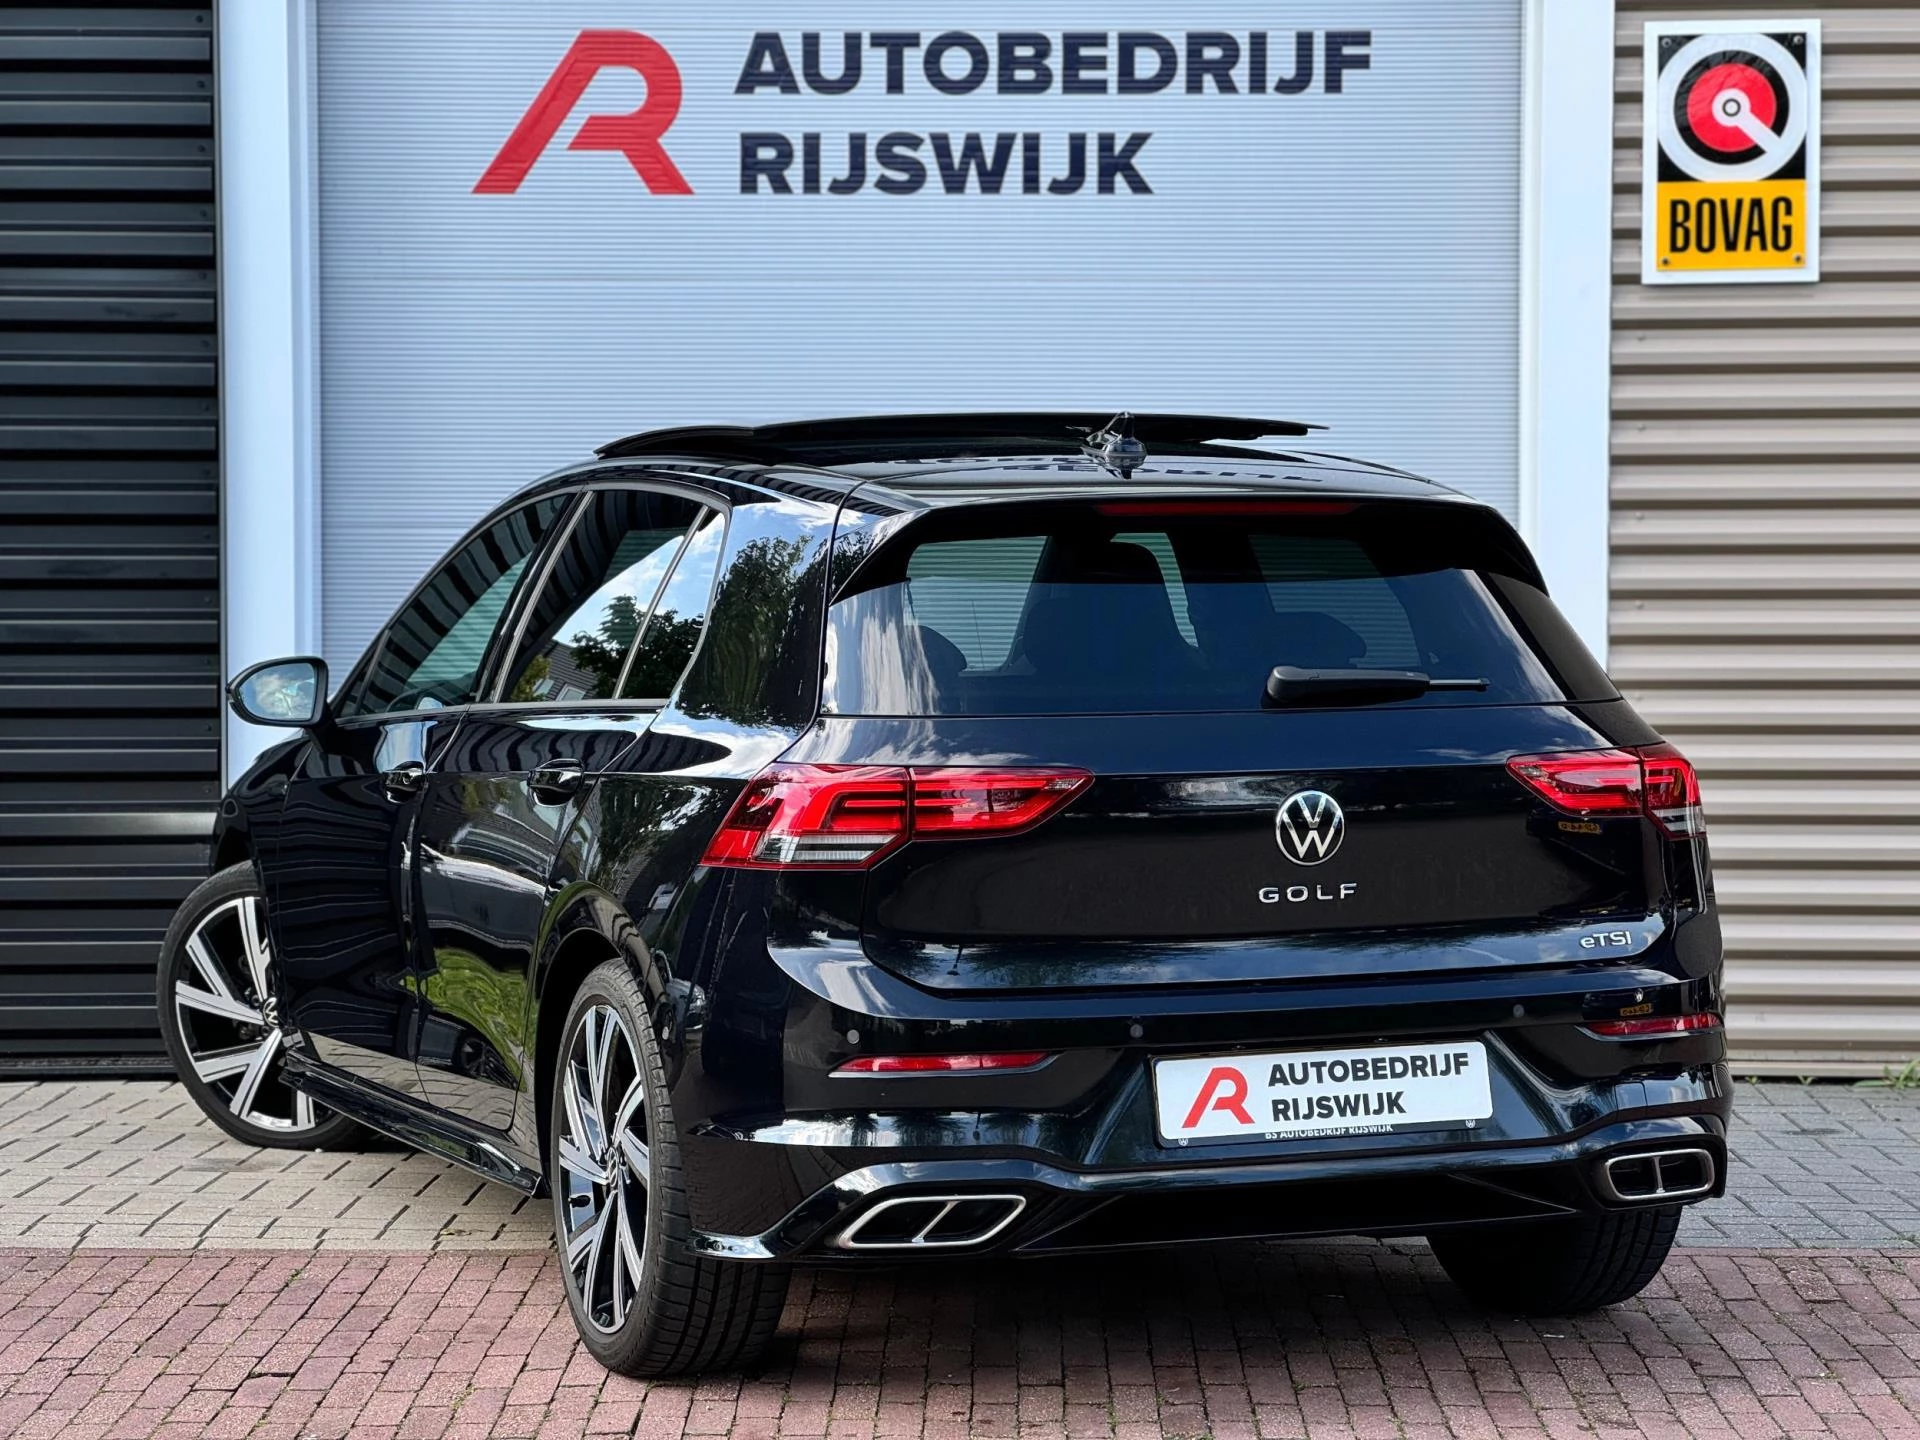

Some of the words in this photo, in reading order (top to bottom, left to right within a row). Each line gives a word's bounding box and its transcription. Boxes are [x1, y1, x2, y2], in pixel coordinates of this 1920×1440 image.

[735, 30, 1371, 96] AUTOBEDRIJF
[739, 131, 1154, 195] RIJSWIJK
[1669, 196, 1793, 254] BOVAG
[1258, 882, 1358, 904] GOLF
[1580, 931, 1633, 949] eTSI
[1267, 1052, 1470, 1088] AUTOBEDRIJF
[1271, 1091, 1407, 1122] RIJSWIJK
[1279, 1127, 1347, 1139] AUTOBEDRIJF
[1348, 1123, 1394, 1135] RIJSWIJK
